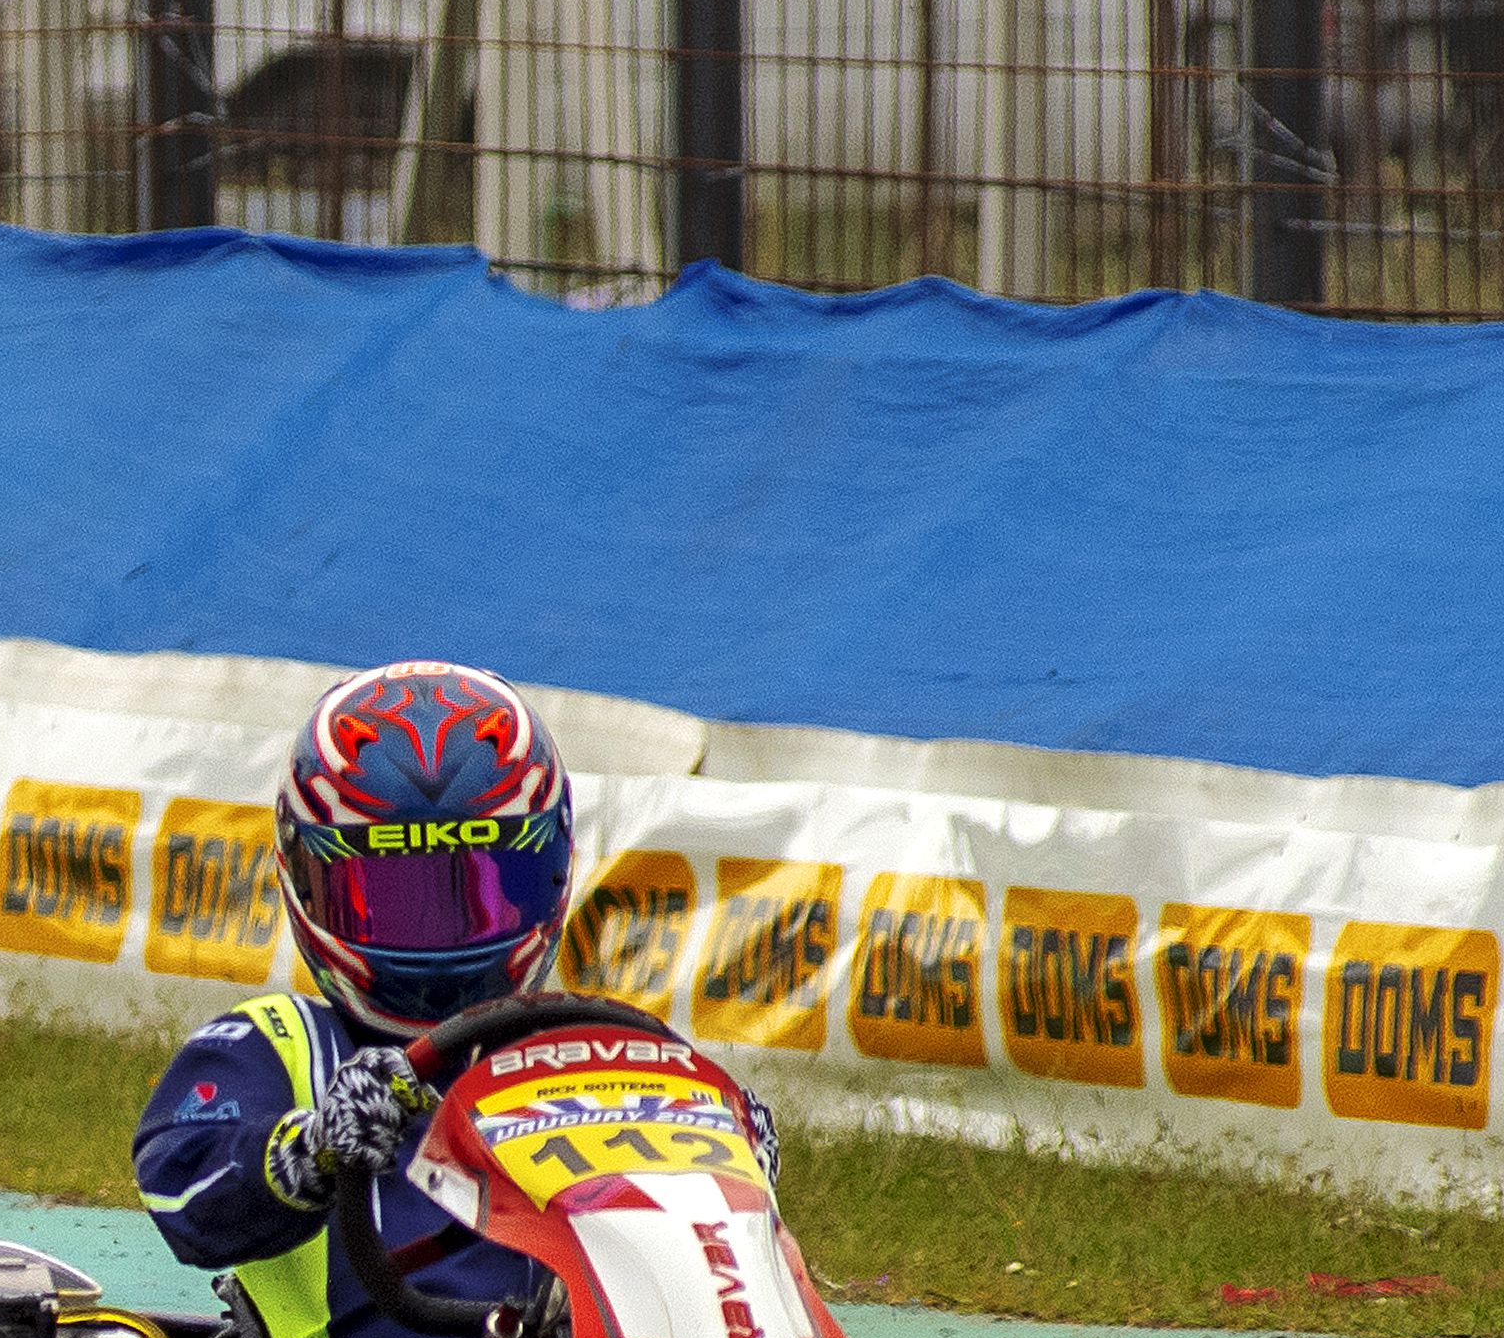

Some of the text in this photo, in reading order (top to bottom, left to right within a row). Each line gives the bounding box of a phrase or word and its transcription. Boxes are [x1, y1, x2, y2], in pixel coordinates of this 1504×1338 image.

[3, 811, 125, 927] DOMS
[161, 832, 280, 947] DOMS
[367, 819, 501, 850] EIKO
[705, 893, 830, 1010] DOMS
[861, 908, 978, 1030] DOMS
[1011, 925, 1136, 1046] DOMS
[1164, 942, 1296, 1066] DOMS
[1336, 960, 1487, 1087] DOMS
[495, 1110, 642, 1143] URUGUAY
[530, 1127, 754, 1177] 112
